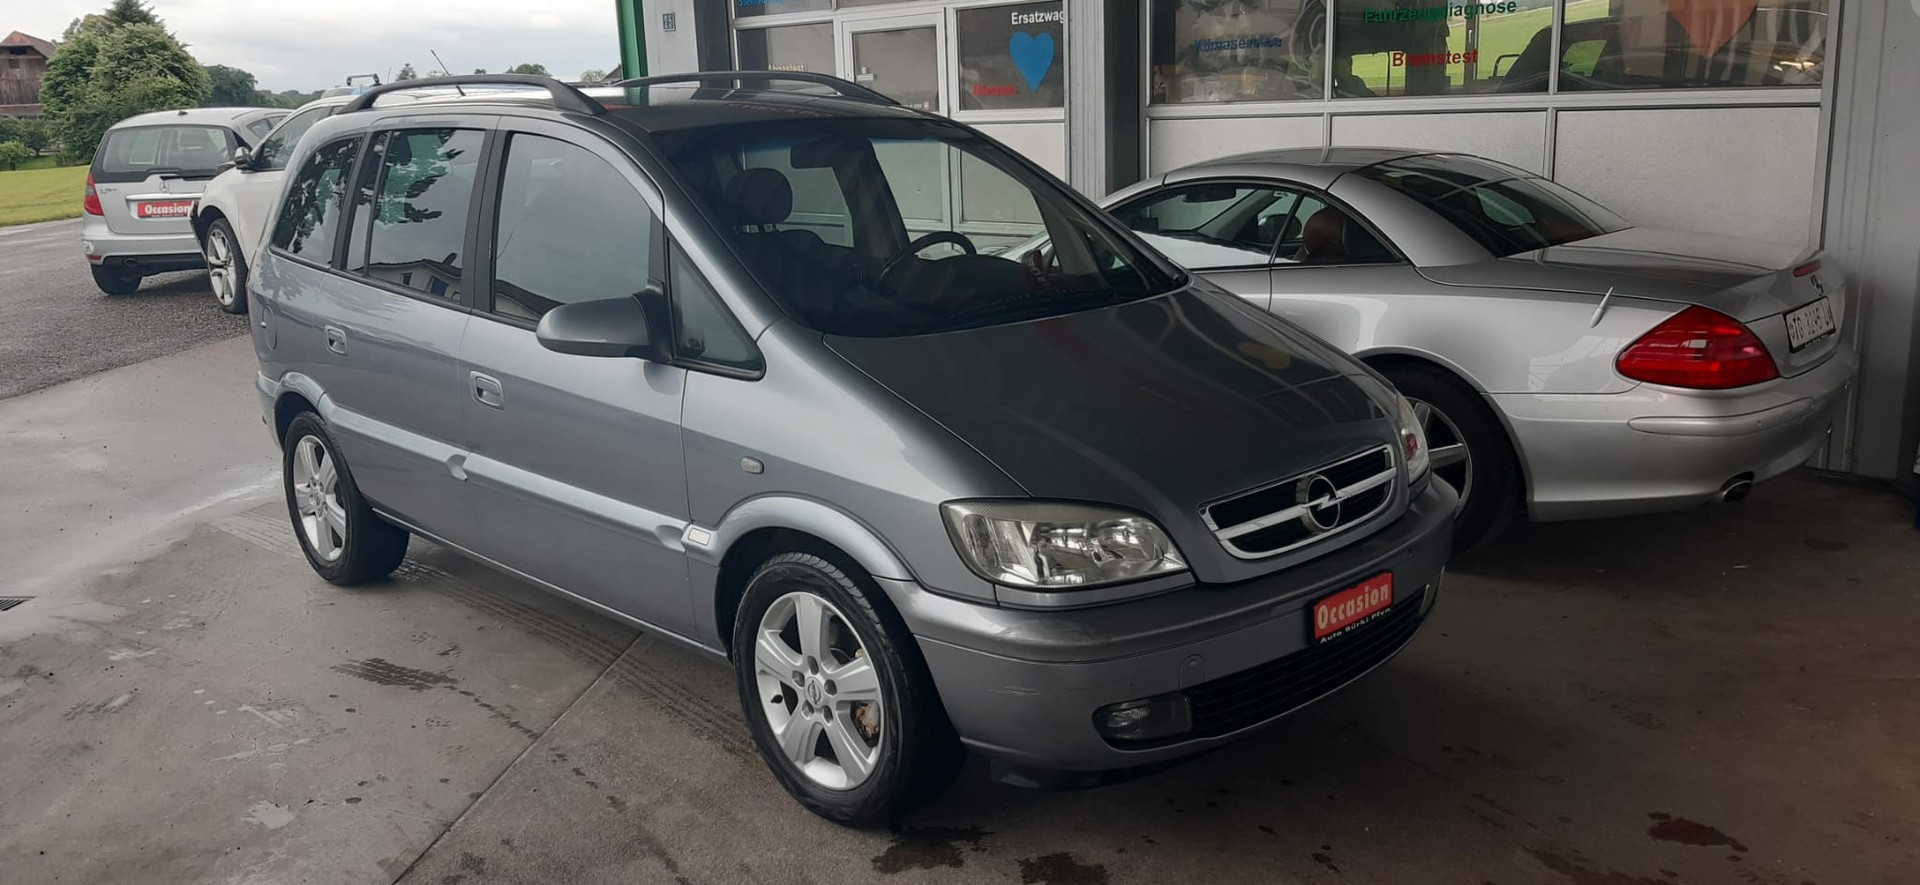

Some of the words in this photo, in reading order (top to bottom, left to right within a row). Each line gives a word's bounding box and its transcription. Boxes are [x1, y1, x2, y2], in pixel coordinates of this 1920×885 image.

[1364, 1, 1517, 23] Fahrzeugdiagnose
[1392, 48, 1479, 66] Bremstest
[1317, 583, 1389, 630] Occasion
[1320, 631, 1342, 644] Auto
[1344, 617, 1369, 632] Bürki
